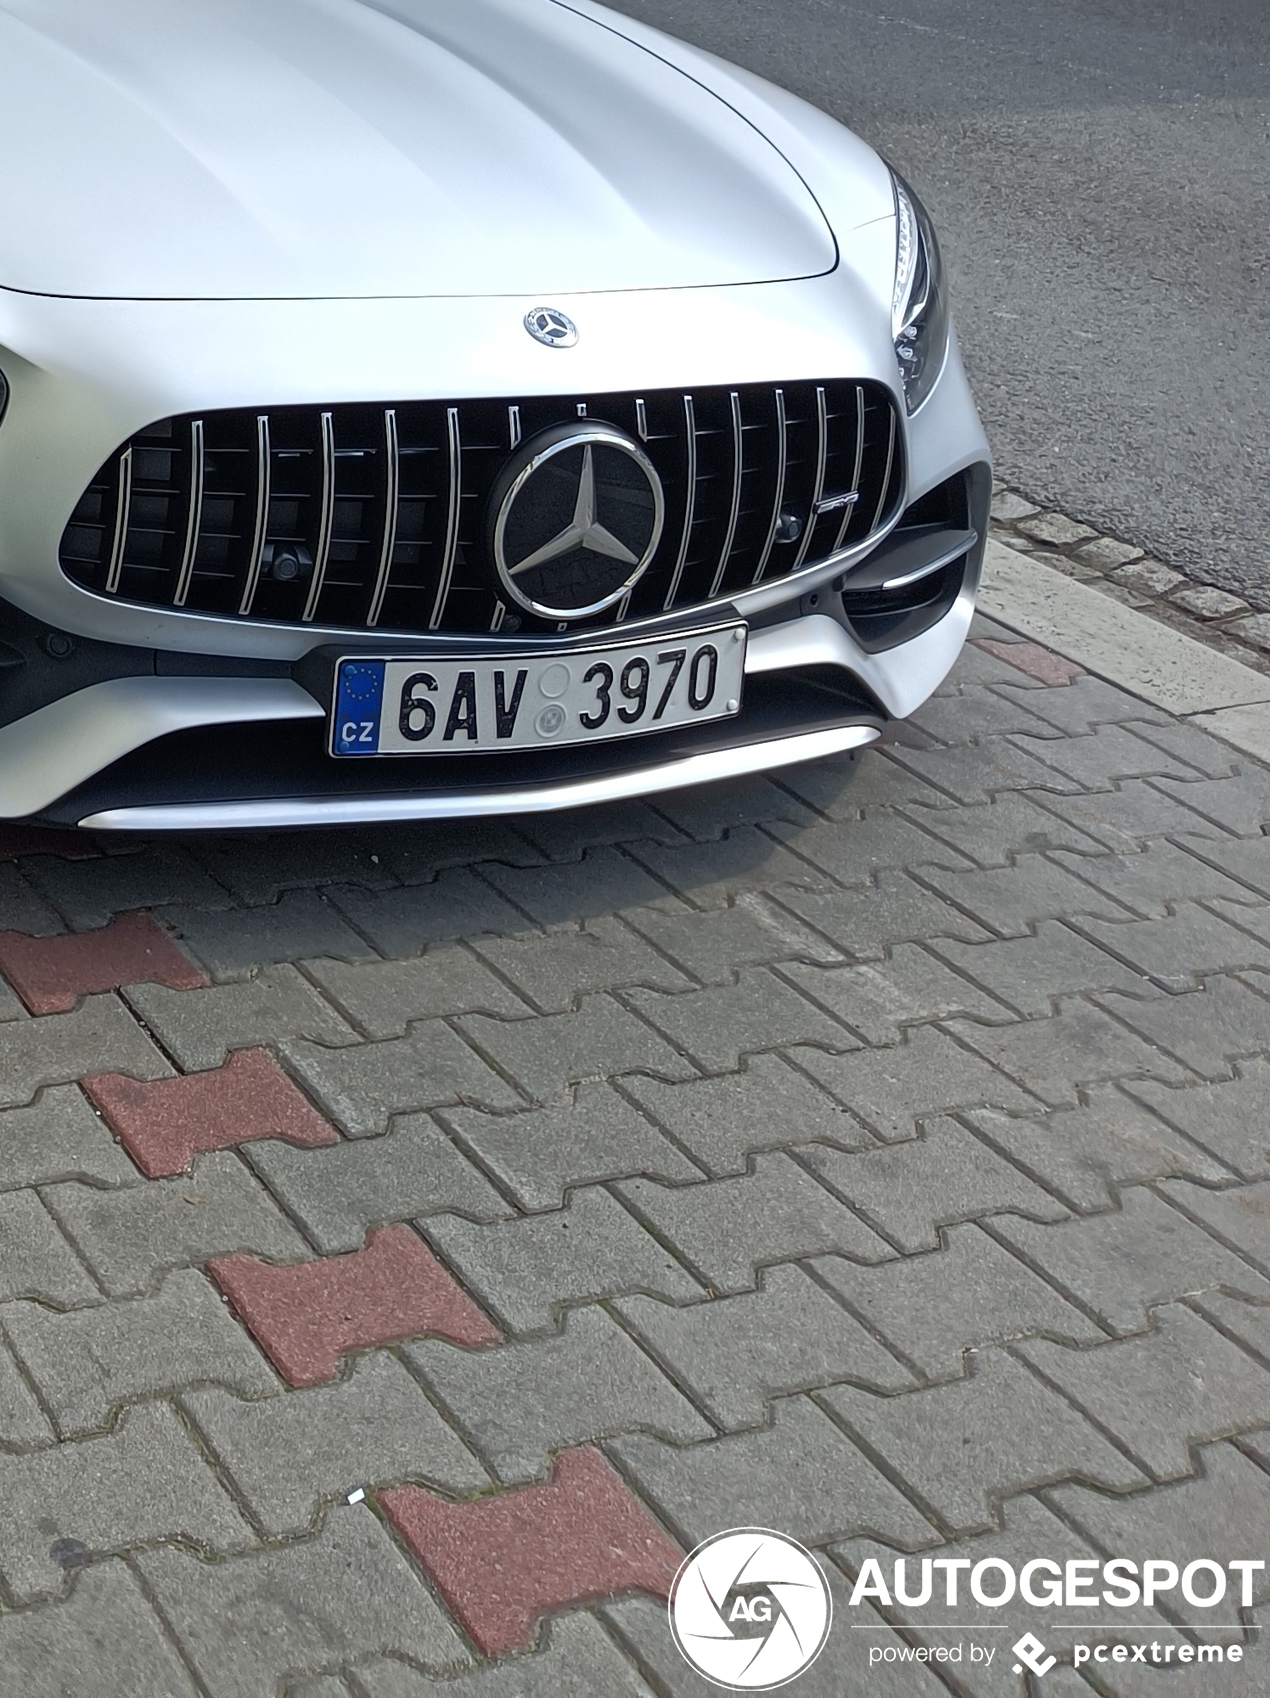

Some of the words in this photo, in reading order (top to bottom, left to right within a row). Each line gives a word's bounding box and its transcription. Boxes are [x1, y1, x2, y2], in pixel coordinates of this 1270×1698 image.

[397, 666, 529, 743] 6AV
[578, 644, 720, 731] 3970
[340, 721, 374, 743] CZ
